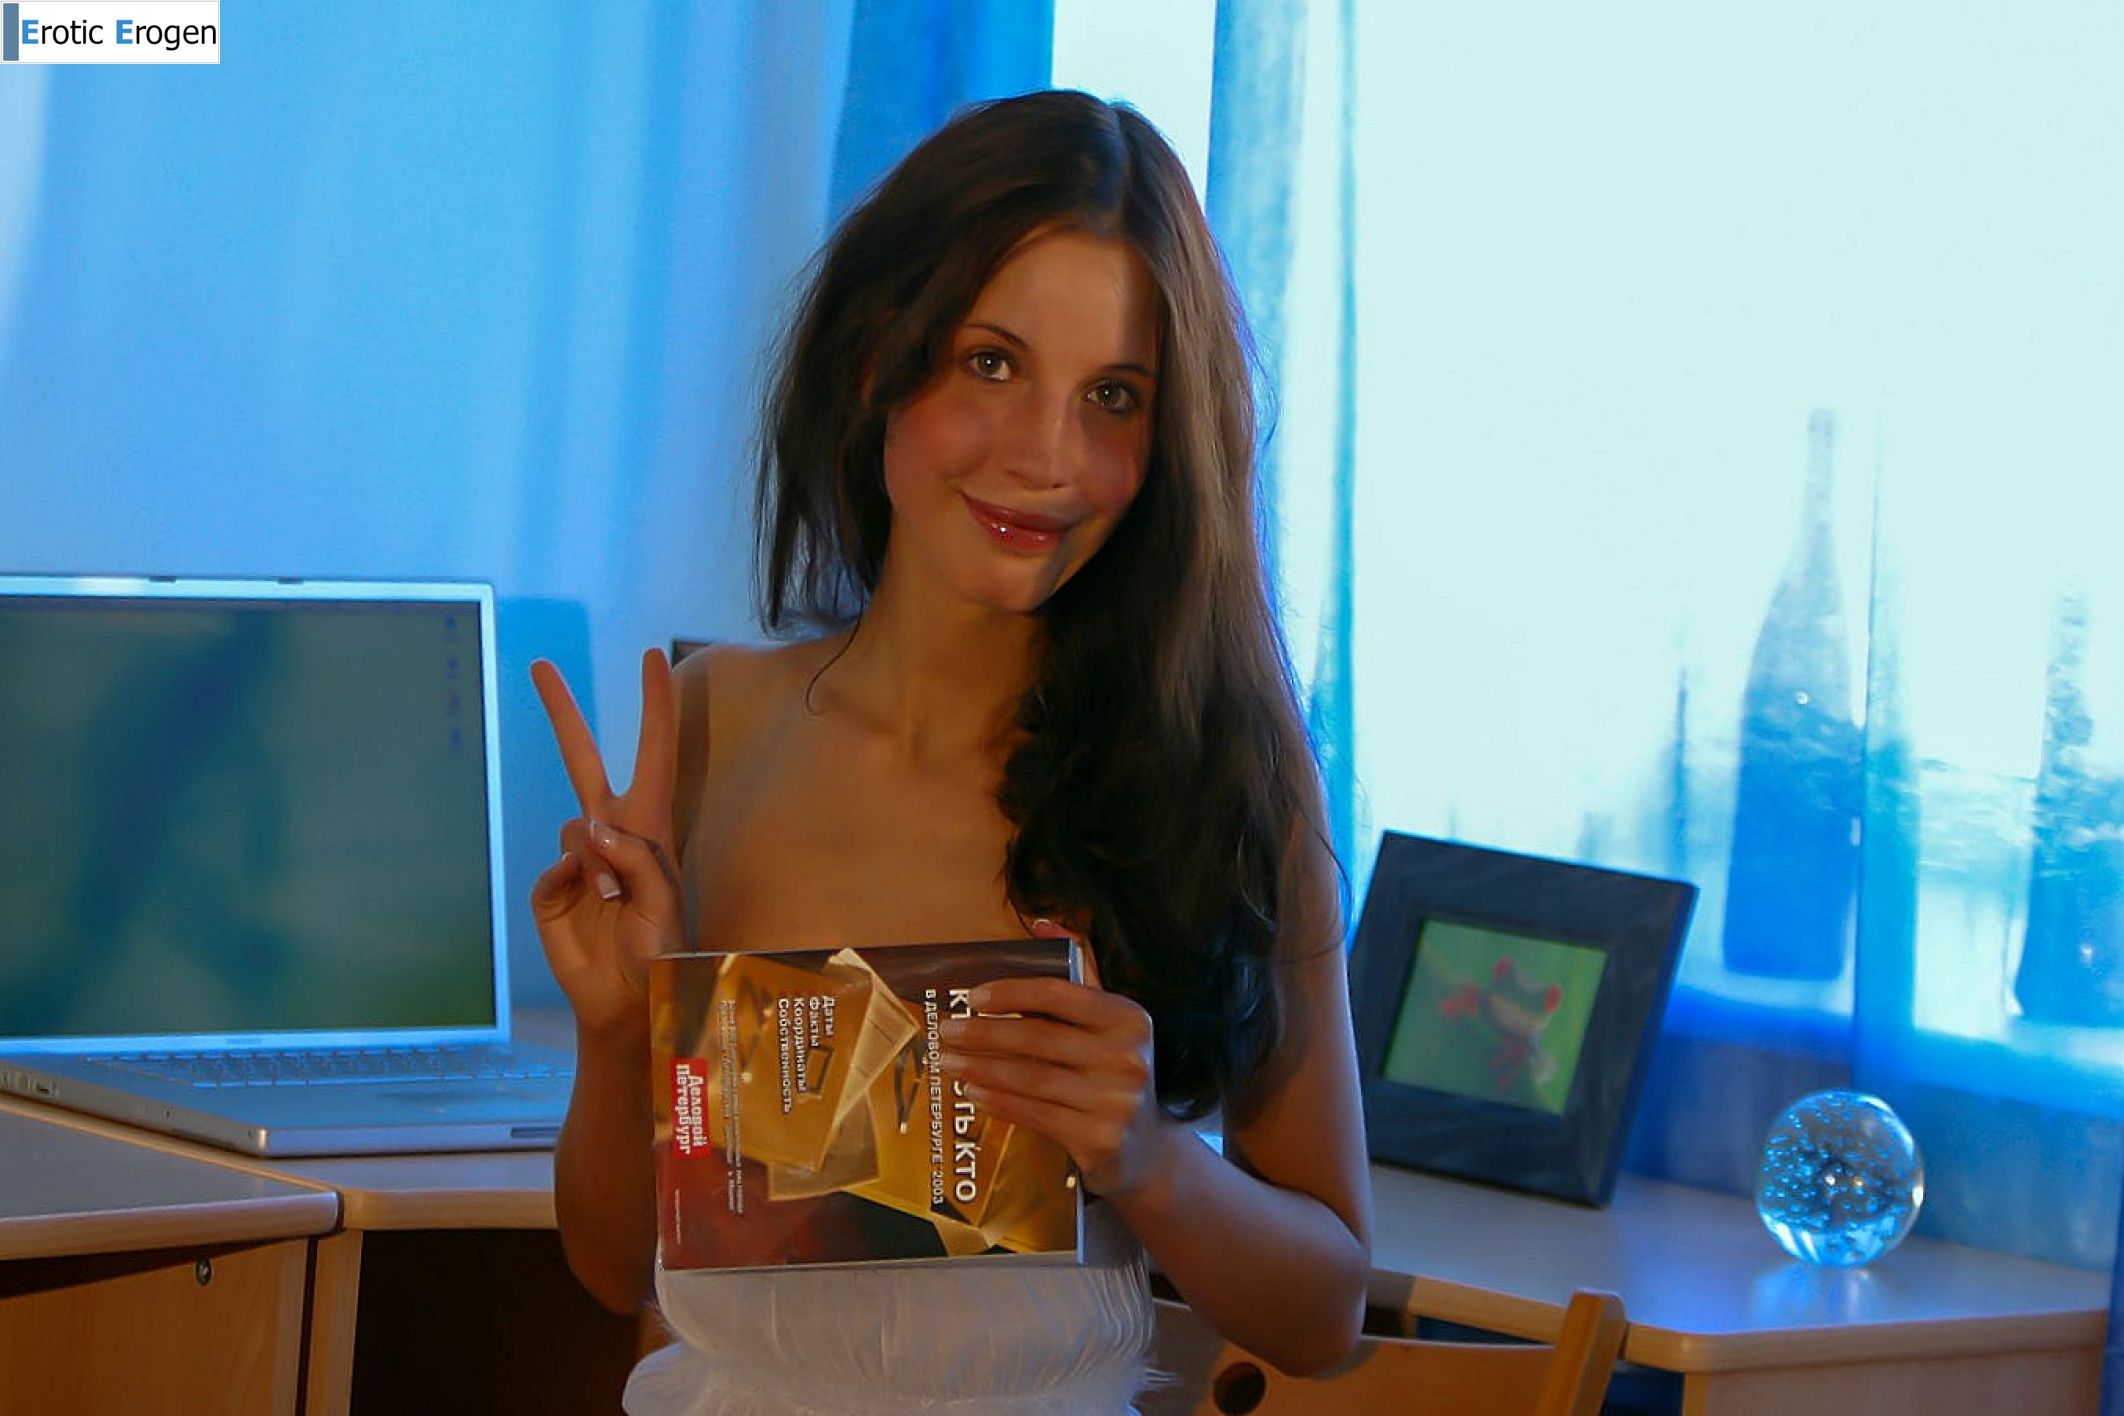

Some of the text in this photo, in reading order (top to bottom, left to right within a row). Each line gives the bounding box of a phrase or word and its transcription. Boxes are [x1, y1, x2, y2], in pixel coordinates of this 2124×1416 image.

[809, 997, 821, 1047] Факты
[823, 995, 836, 1037] Даты
[925, 988, 936, 999] В
[778, 998, 792, 1114] Собственность
[793, 997, 807, 1092] Координаты
[925, 1003, 941, 1073] ДЕЛОВОМ
[675, 1063, 692, 1155] Петербург
[687, 1074, 707, 1148] Деловой
[930, 1077, 943, 1164] ПЕТЕРБУРГЕ
[954, 1143, 977, 1203] КТО
